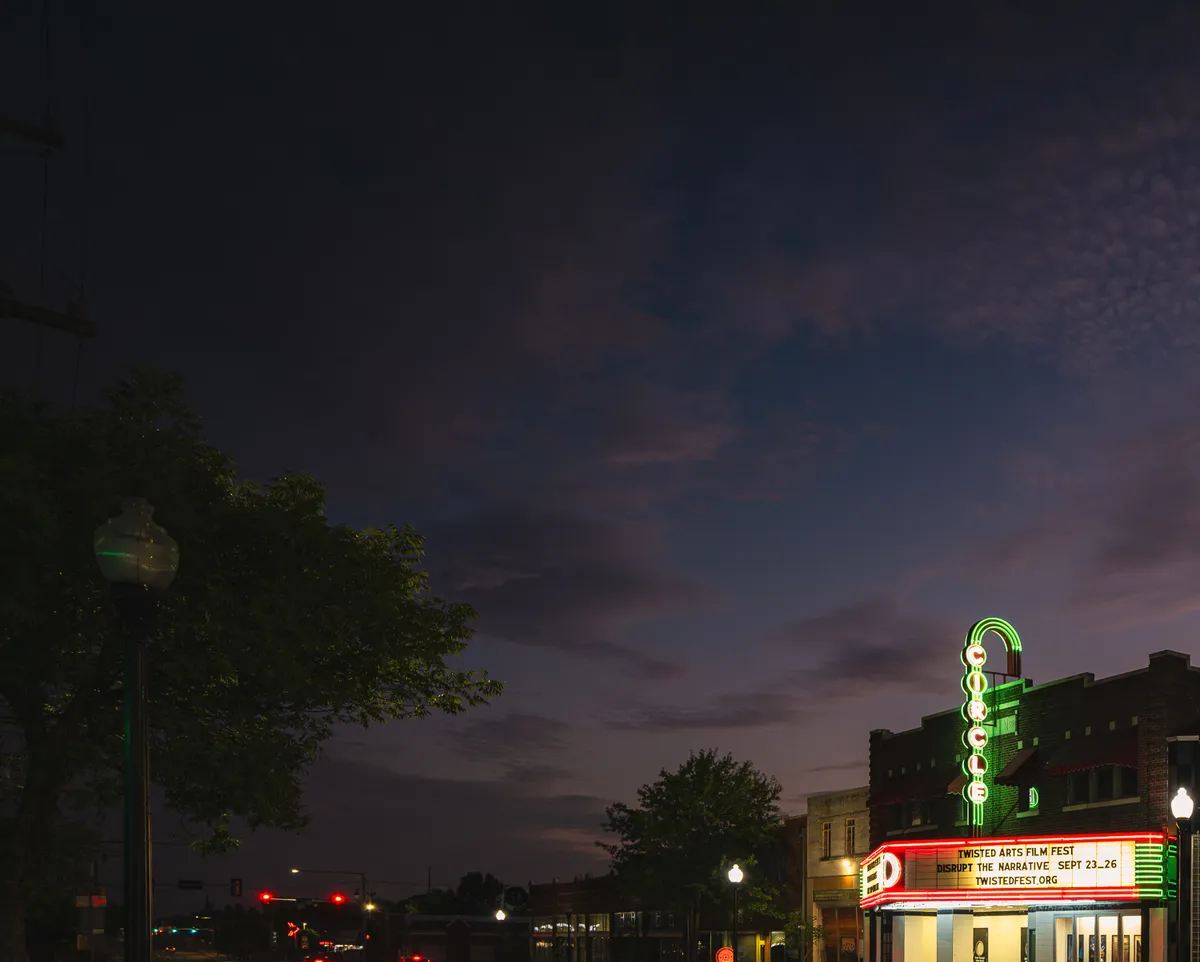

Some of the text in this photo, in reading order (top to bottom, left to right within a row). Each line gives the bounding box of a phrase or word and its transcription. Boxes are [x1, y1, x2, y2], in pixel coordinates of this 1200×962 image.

[966, 645, 987, 803] CIRCLE
[958, 846, 1074, 858] TWISTED ARTS FILM FEST
[937, 863, 973, 873] DISRUPT
[977, 863, 993, 871] THE
[998, 862, 1049, 871] NARRATIVE
[1058, 861, 1082, 870] SEPT
[976, 876, 1058, 885] TWISTEDFEST.ORG
